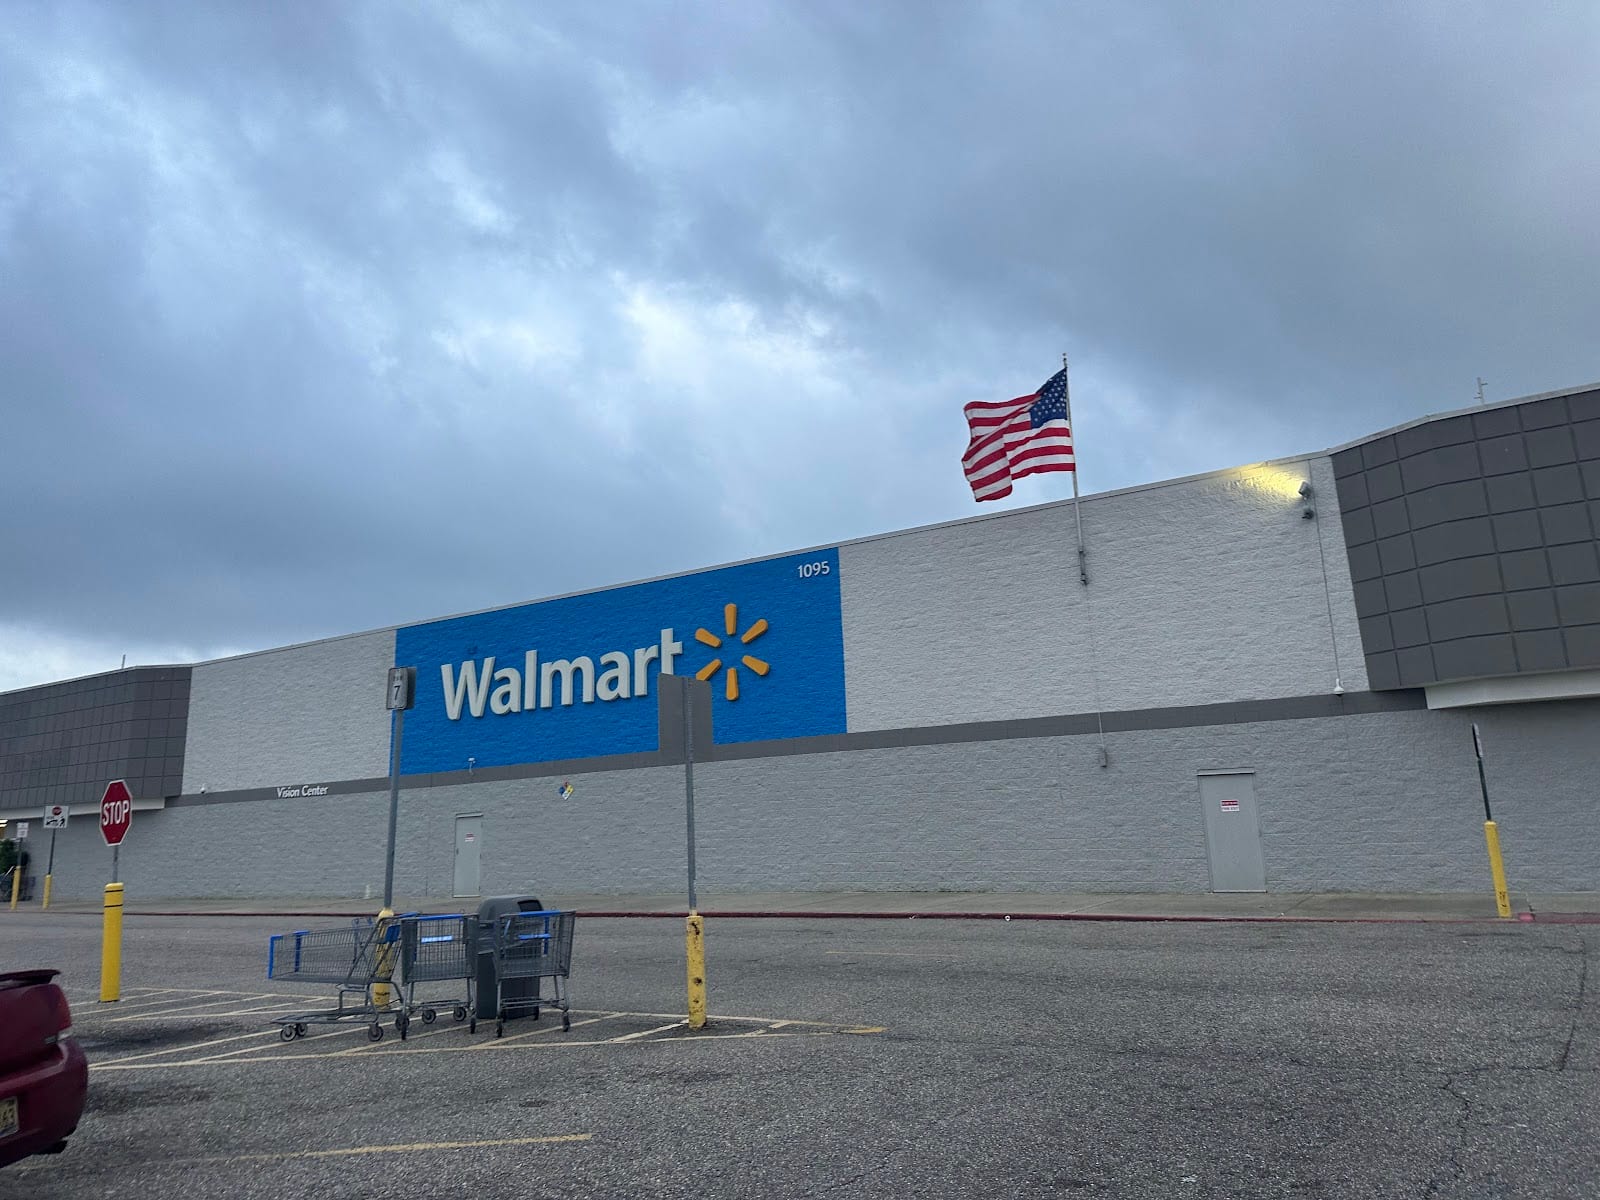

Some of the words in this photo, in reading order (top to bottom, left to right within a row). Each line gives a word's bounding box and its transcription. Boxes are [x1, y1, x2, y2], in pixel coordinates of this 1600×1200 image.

[797, 561, 830, 578] 1095
[440, 628, 683, 720] Walmart
[394, 685, 401, 701] 7
[277, 786, 300, 798] Vision
[301, 785, 328, 797] Center
[102, 800, 129, 826] STOP
